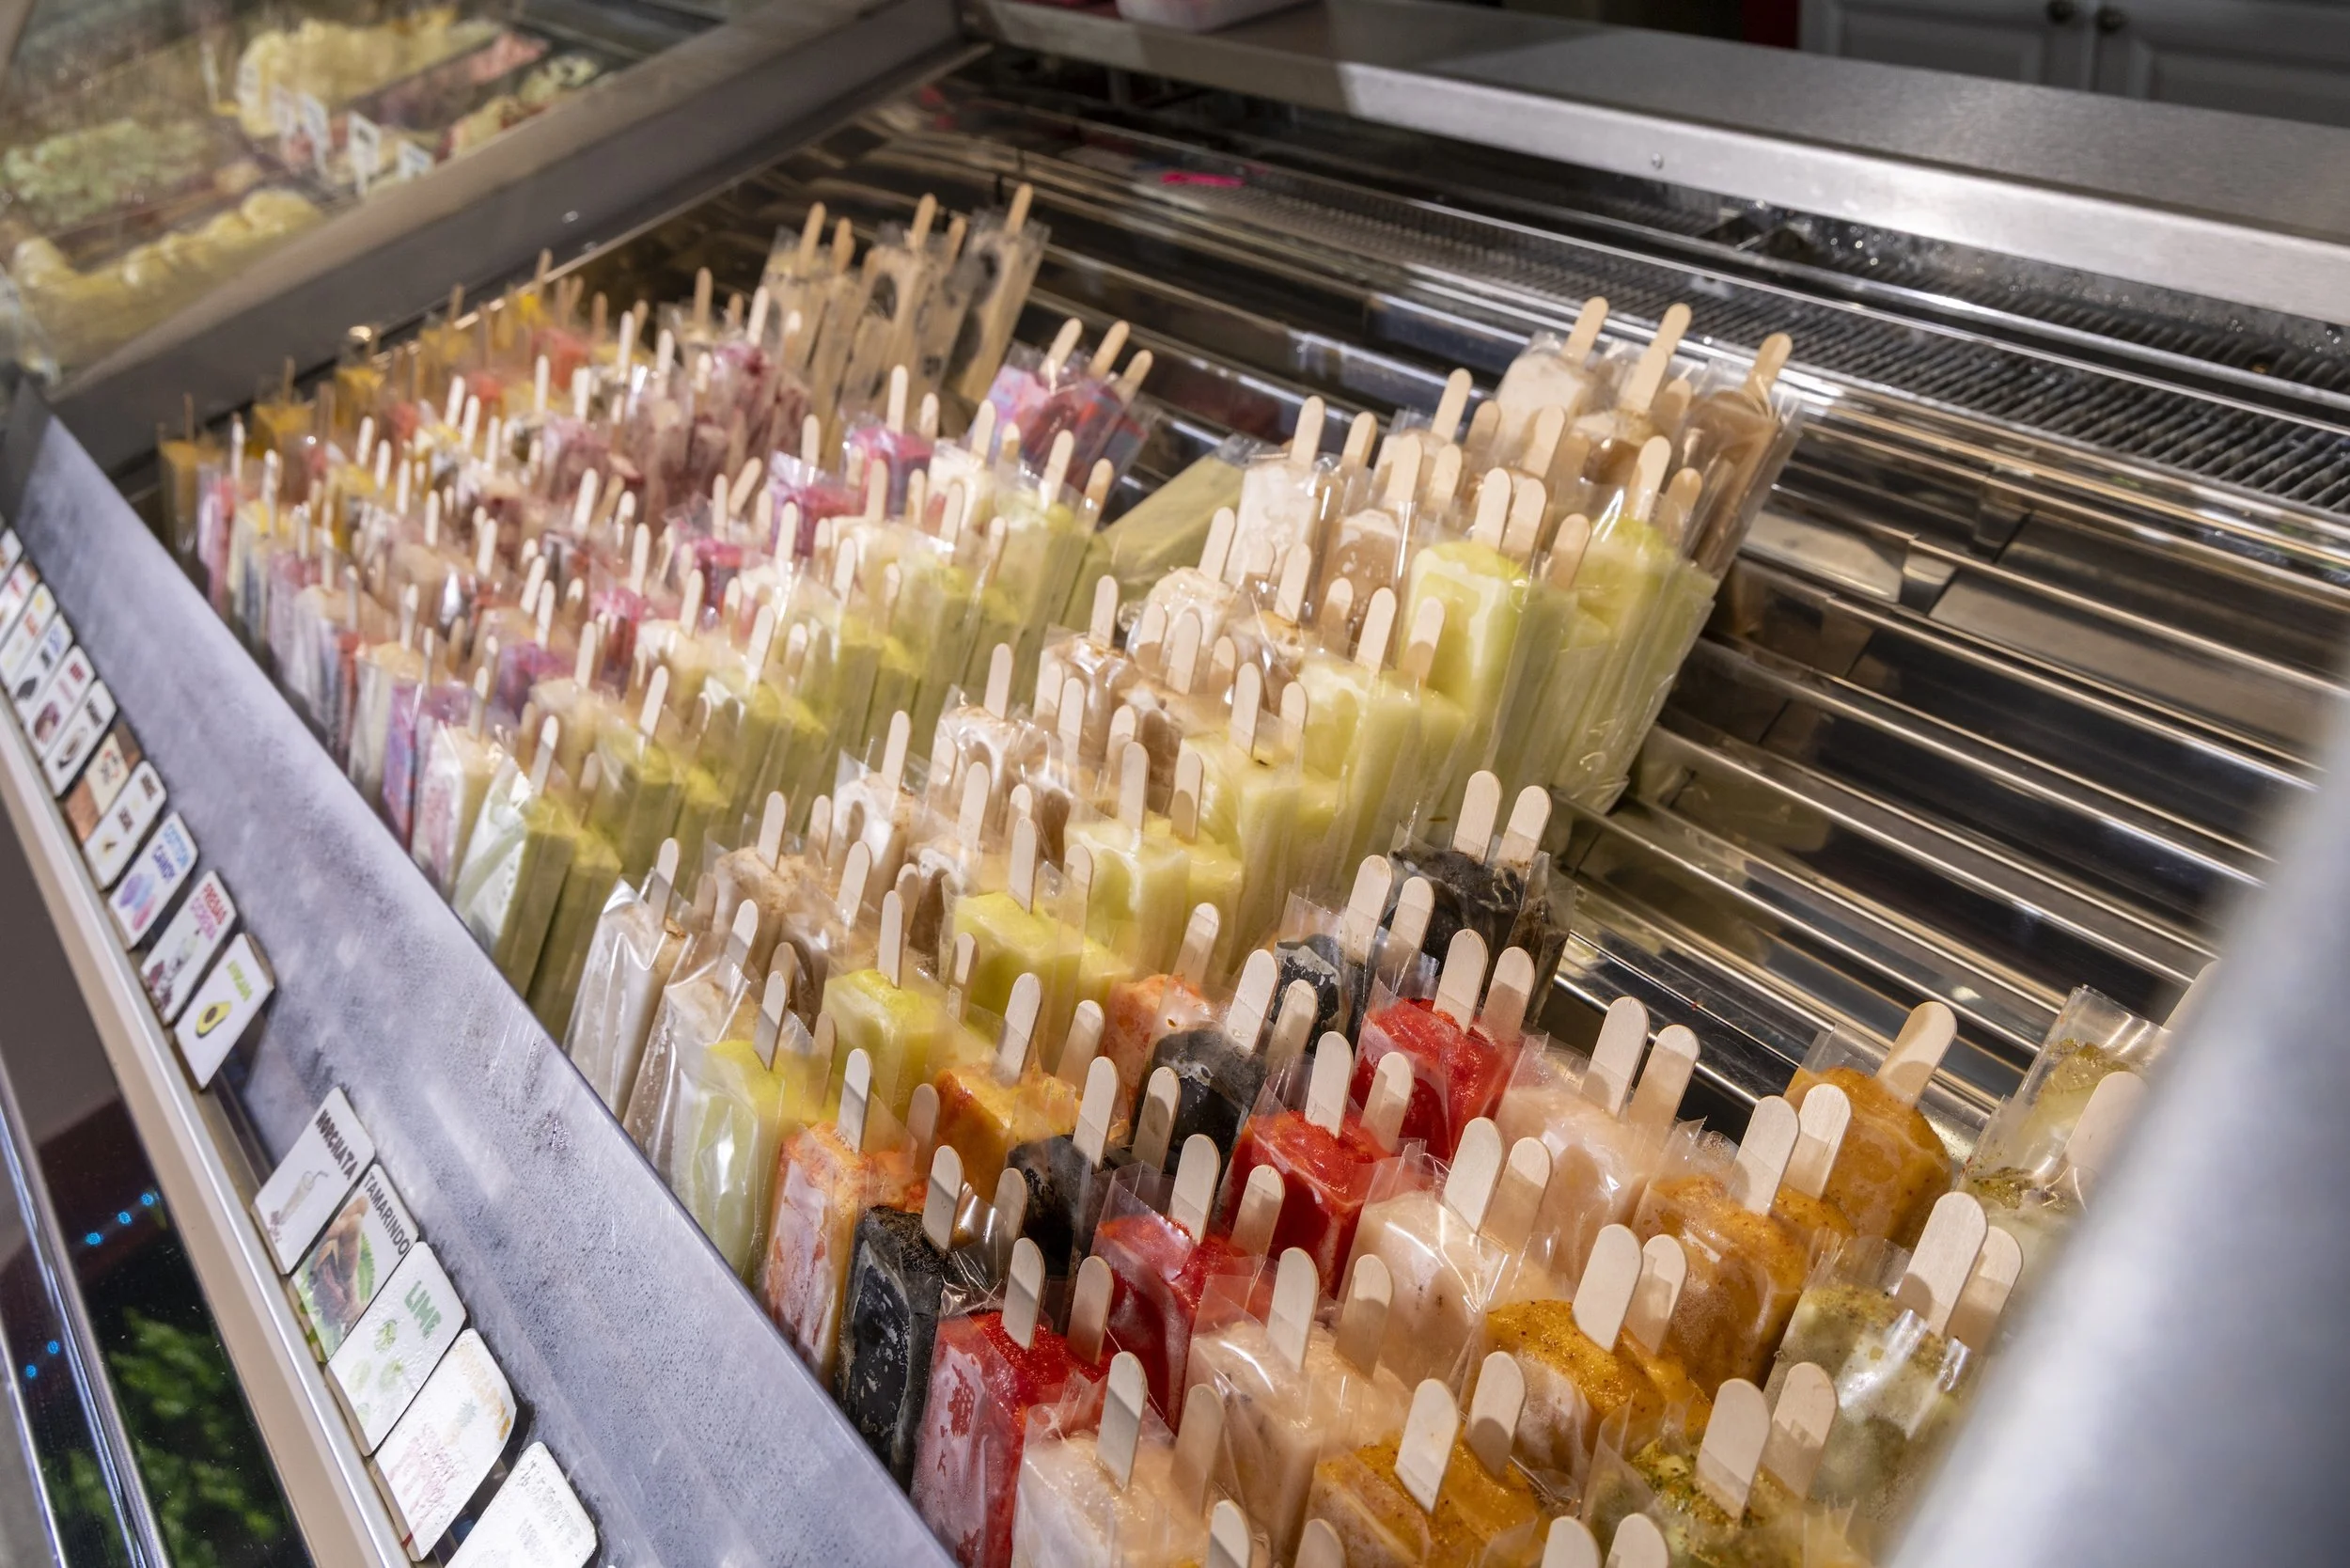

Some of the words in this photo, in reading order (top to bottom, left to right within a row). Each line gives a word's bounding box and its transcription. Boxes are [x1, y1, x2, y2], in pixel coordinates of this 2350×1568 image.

[315, 1108, 359, 1181] HORCHATA
[363, 1171, 410, 1256] TAMARINDO
[404, 1279, 442, 1340] LIME
